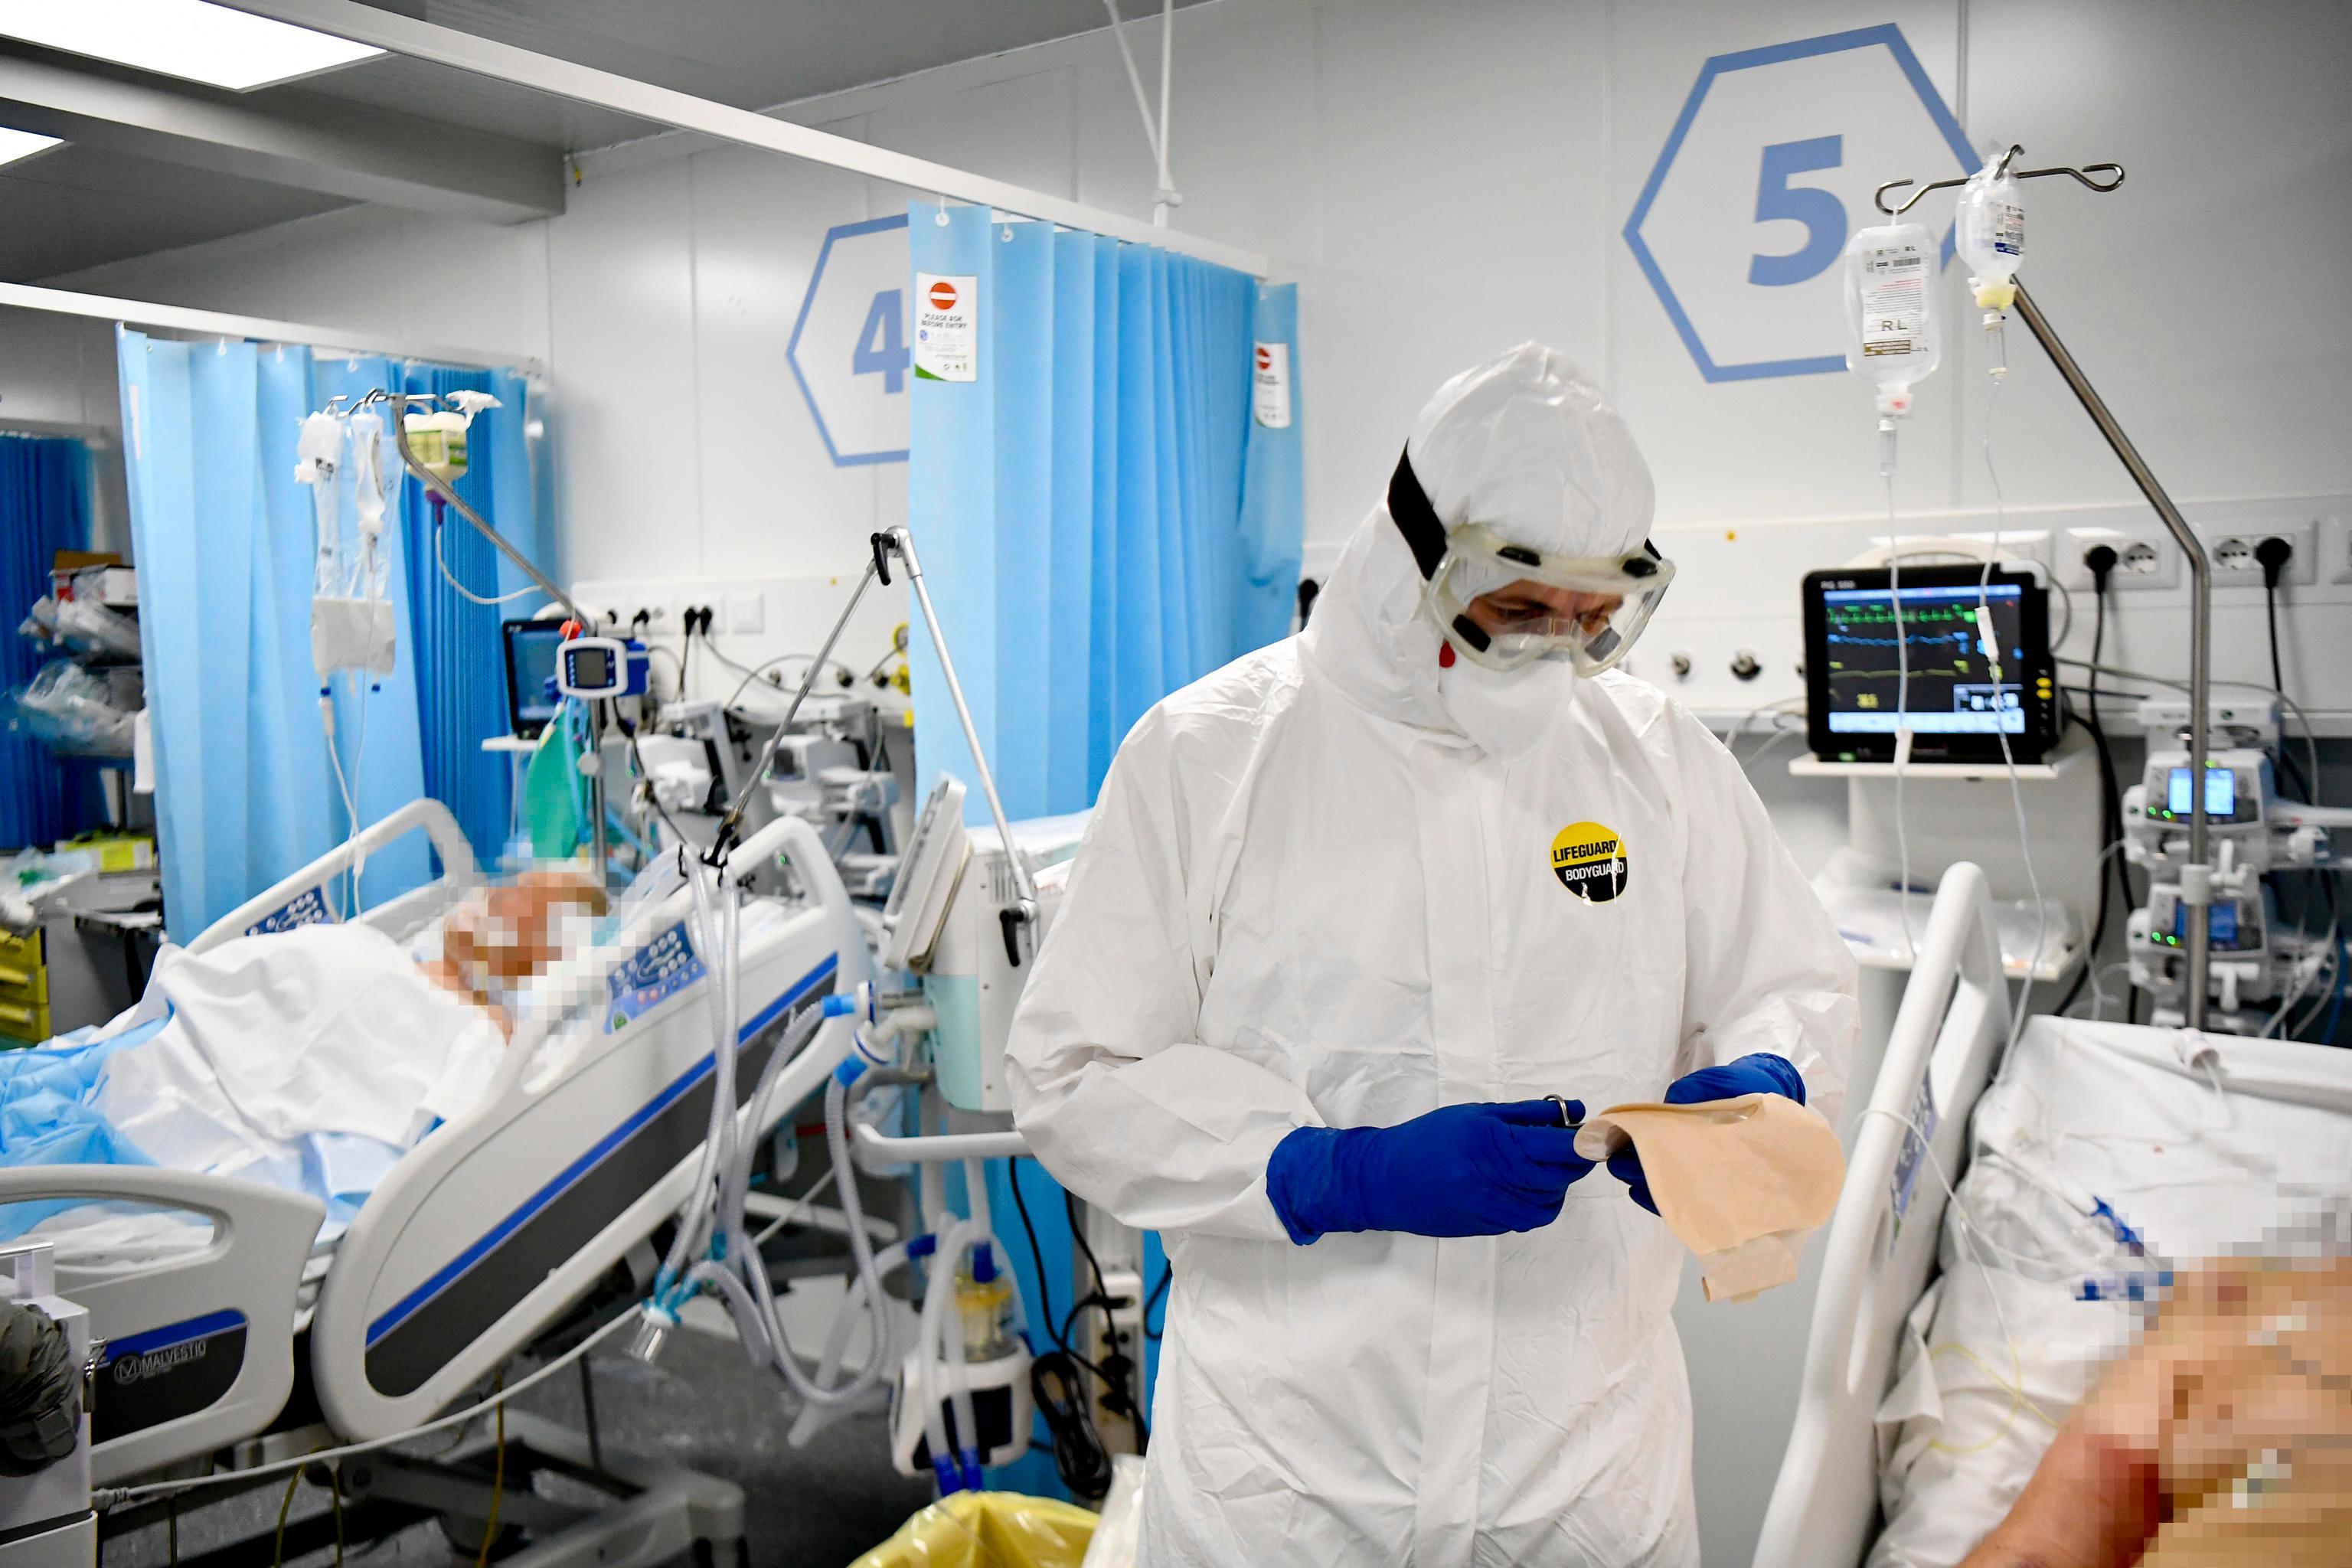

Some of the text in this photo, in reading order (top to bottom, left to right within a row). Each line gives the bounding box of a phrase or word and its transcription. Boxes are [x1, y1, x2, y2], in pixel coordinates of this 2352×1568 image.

[1747, 134, 1847, 286] 5
[853, 288, 910, 394] 4
[1553, 840, 1617, 862] LIFEGUARD
[1565, 861, 1624, 881] BODYGUAD
[142, 1340, 207, 1373] MALVESTIO
